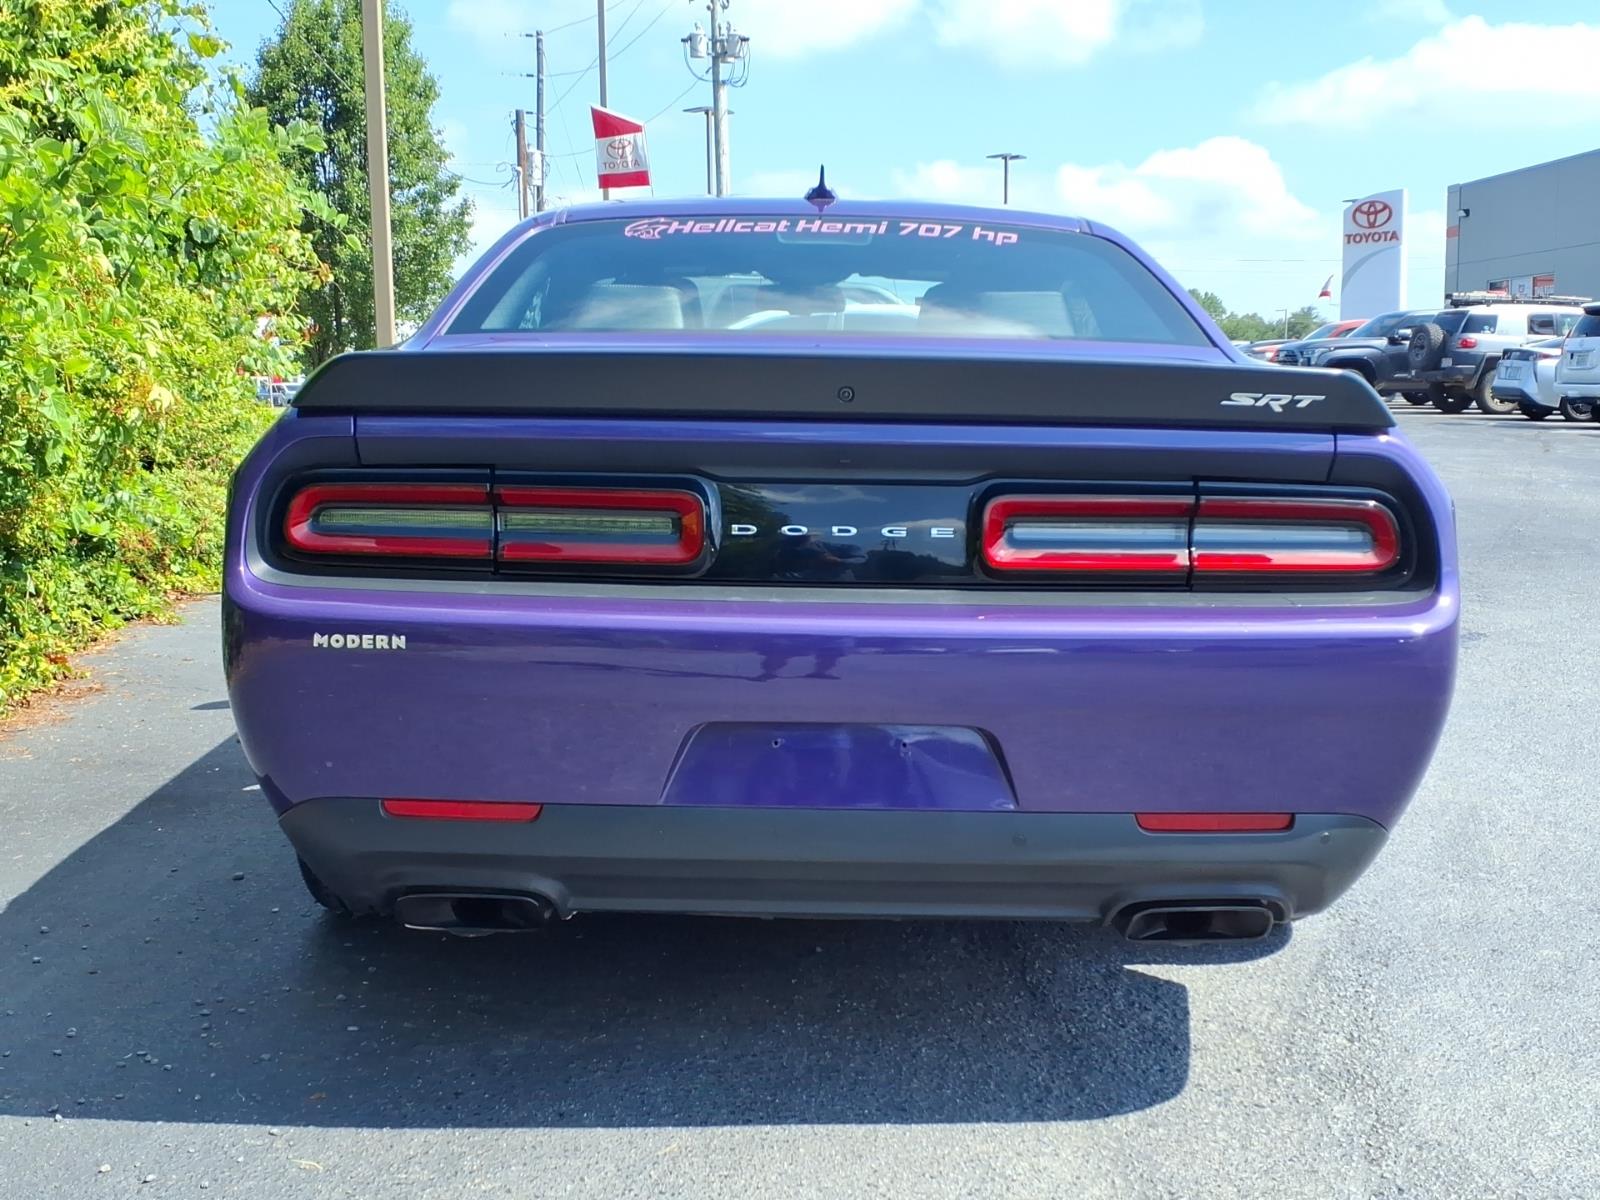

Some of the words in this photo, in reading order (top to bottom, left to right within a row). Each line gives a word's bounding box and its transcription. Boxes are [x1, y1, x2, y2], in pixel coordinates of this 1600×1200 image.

[667, 218, 790, 234] Hellcat
[795, 219, 888, 235] Hemi
[899, 222, 962, 238] 707
[972, 226, 1018, 245] hp
[1344, 230, 1399, 244] TOYOTA
[1220, 392, 1326, 412] SRT
[731, 524, 955, 538] DODGE
[313, 632, 406, 649] MODERN
